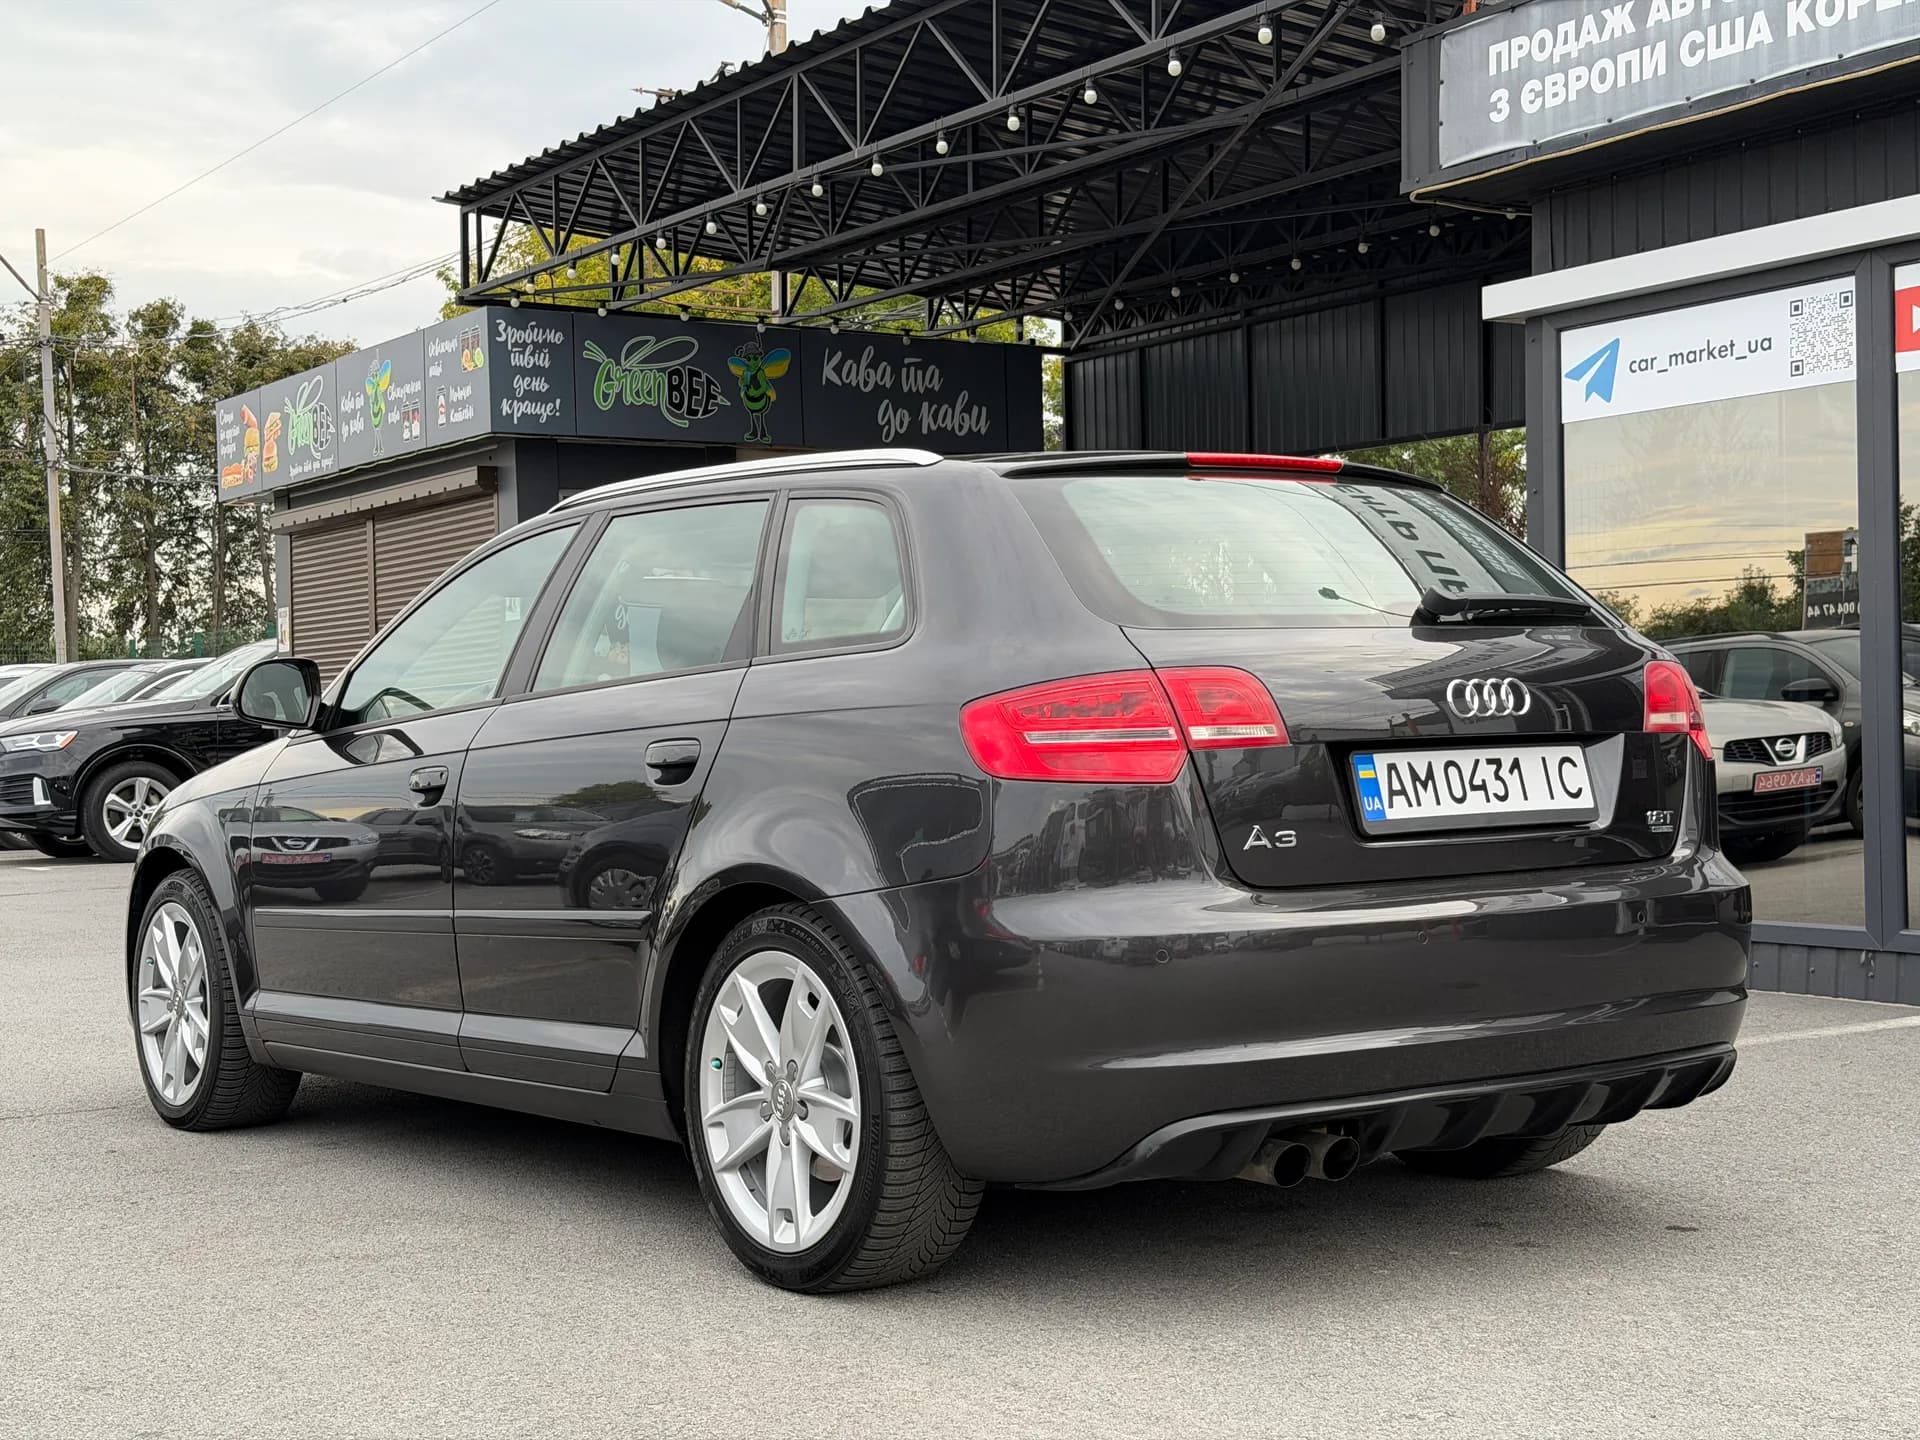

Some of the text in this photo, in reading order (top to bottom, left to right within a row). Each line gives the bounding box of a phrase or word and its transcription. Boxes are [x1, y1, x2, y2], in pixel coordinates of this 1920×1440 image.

[1488, 0, 1736, 77] ПРОДАЖ АВ
[1520, 40, 1666, 114] ЄВРОПИ
[1679, 10, 1774, 67] США
[495, 319, 564, 350] Зробимо
[511, 344, 550, 368] твій
[822, 345, 944, 394] Кава та
[1628, 336, 1773, 374] car_market_ua
[513, 374, 550, 398] день
[501, 398, 561, 424] краще!
[877, 390, 990, 443] до кави
[1363, 796, 1384, 812] UA
[1243, 824, 1298, 851] A3
